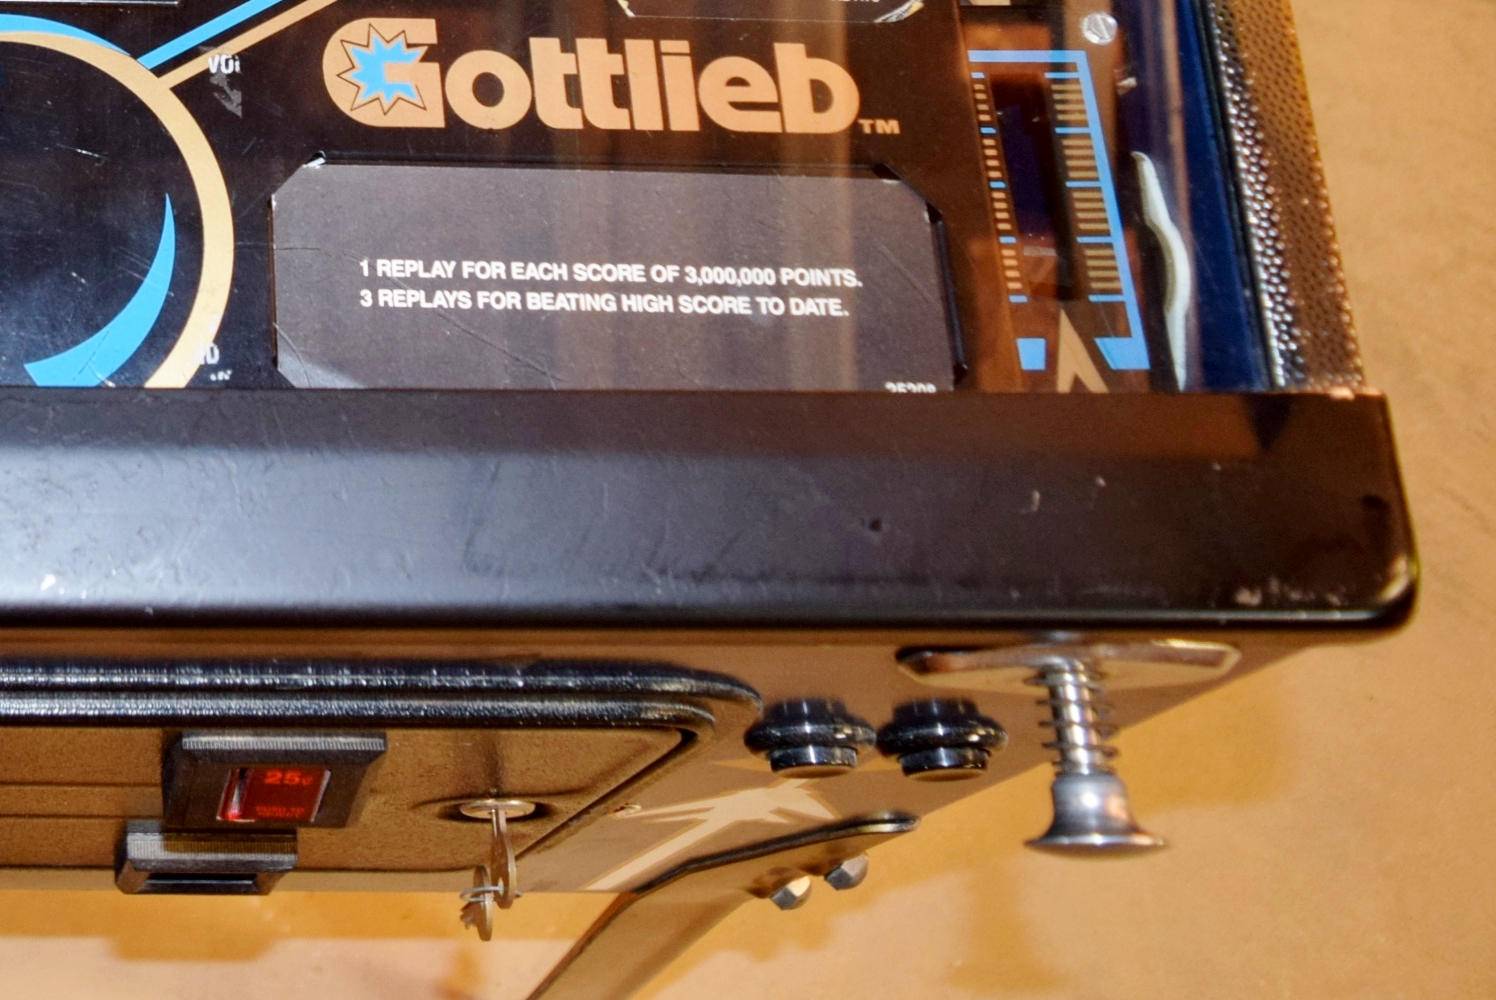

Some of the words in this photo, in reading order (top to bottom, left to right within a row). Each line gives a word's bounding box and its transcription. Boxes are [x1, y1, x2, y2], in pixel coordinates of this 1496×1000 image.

[322, 17, 860, 134] Gottlieb
[360, 259, 368, 276] 1
[377, 259, 456, 278] REPLAY
[462, 261, 506, 279] FOR
[511, 262, 568, 280] EACH
[573, 263, 646, 282] SCORE
[650, 264, 680, 282] OF
[684, 266, 776, 285] 3,000,000
[780, 268, 863, 287] POINTS.
[360, 289, 372, 307] 3
[378, 289, 472, 309] REPLAYS
[477, 291, 522, 310] FOR
[526, 293, 617, 312] BEATING
[621, 295, 674, 312] HIGH
[678, 295, 752, 314] SCORE
[756, 297, 785, 315] TO
[789, 298, 849, 316] DATE.
